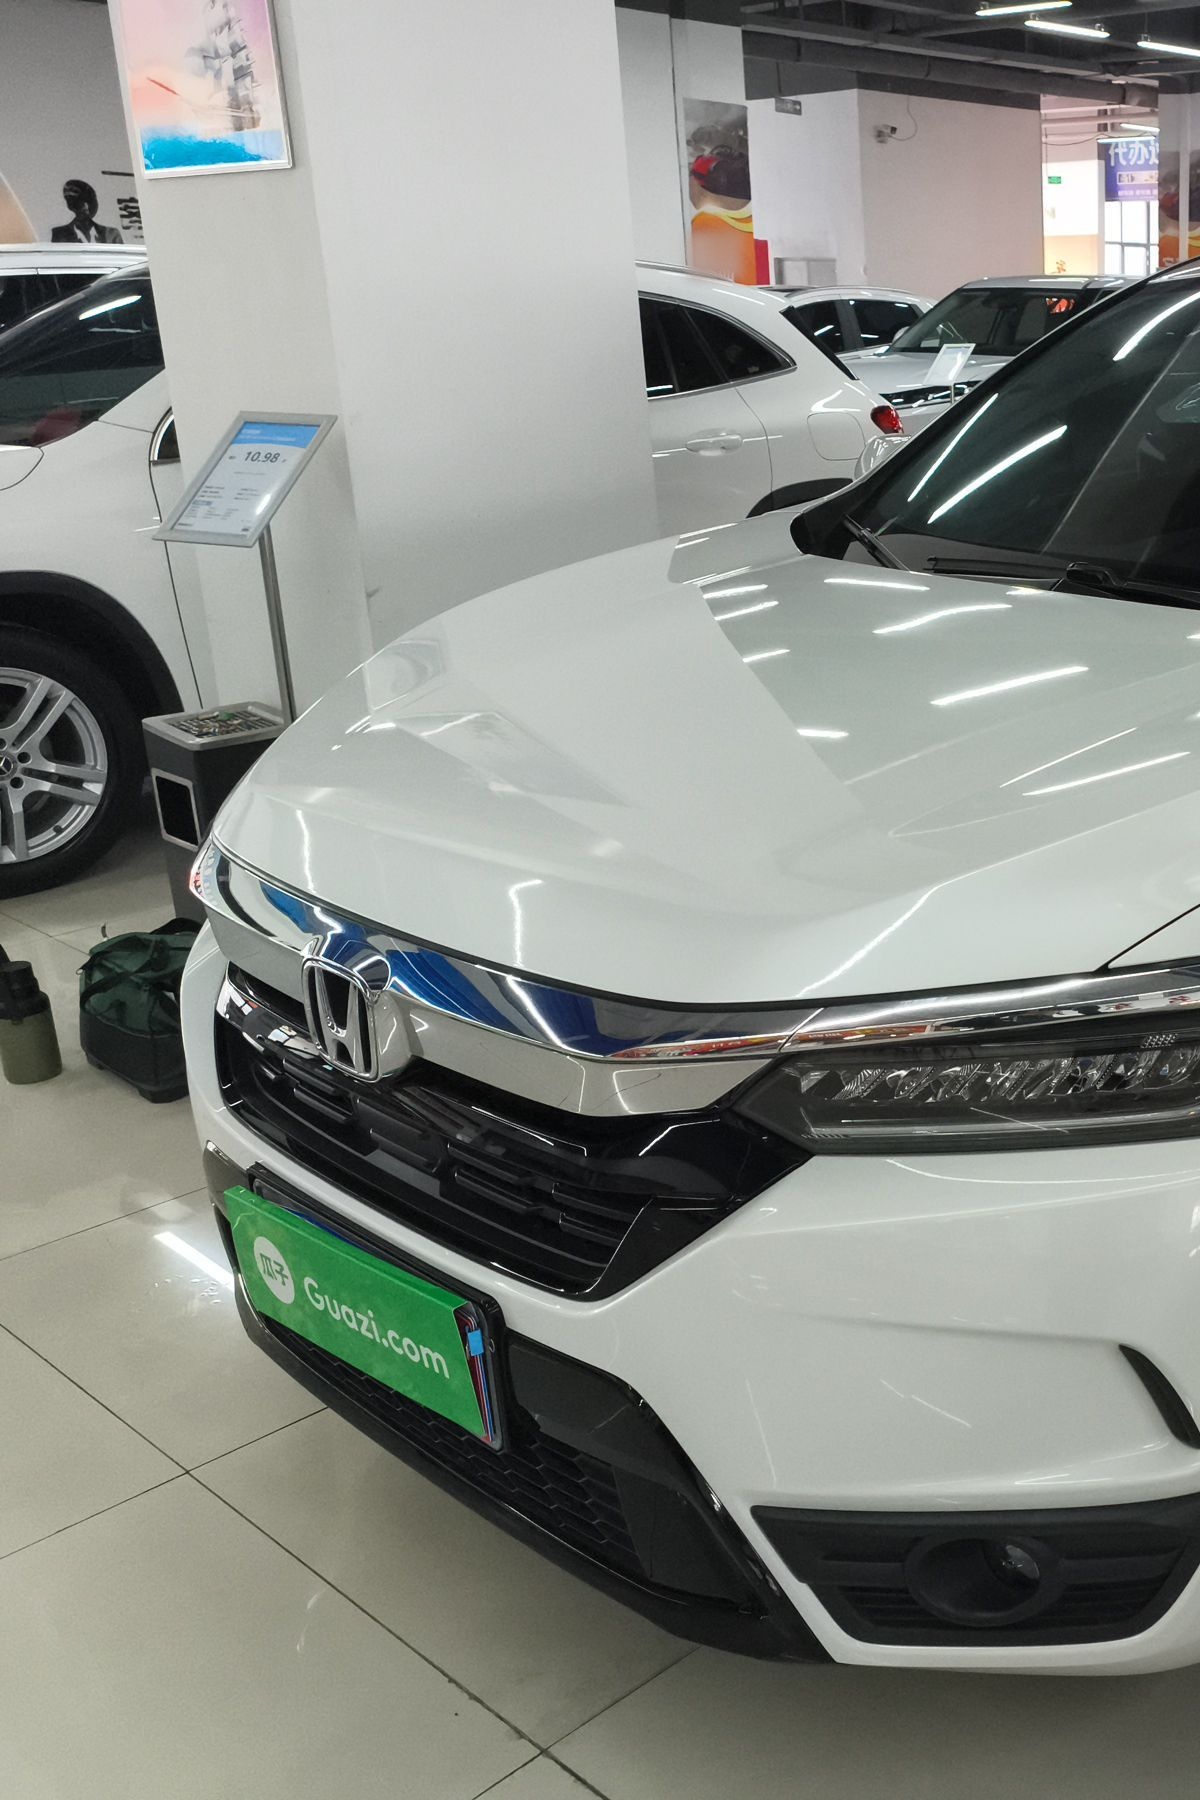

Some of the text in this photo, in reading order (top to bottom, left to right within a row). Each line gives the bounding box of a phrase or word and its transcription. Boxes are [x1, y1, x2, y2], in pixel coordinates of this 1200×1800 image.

[244, 451, 281, 463] 10.98
[259, 1252, 289, 1286] 瓜子
[303, 1276, 449, 1379] Guazi.com
